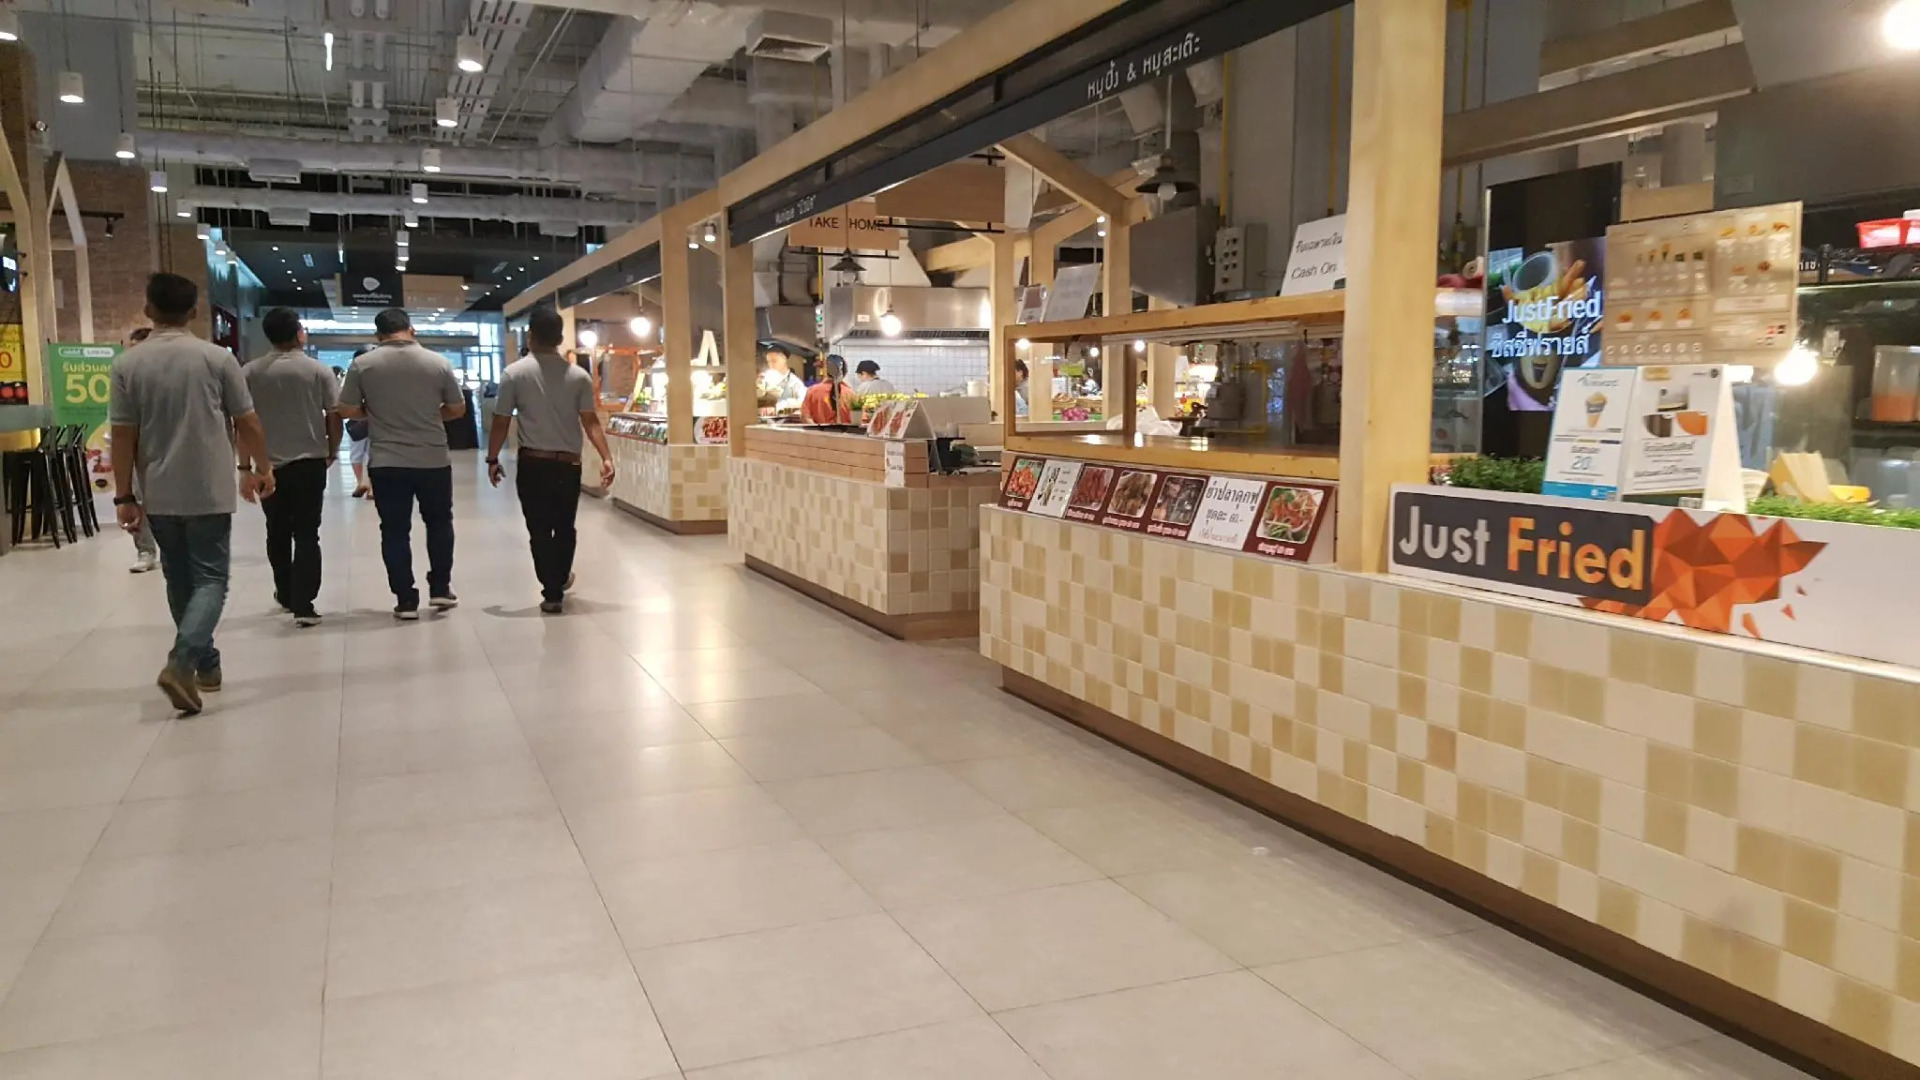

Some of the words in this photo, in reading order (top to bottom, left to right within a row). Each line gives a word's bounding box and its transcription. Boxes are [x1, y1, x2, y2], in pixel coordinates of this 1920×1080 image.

[1126, 62, 1137, 82] &
[849, 218, 885, 231] HOME
[1291, 266, 1318, 280] Cash
[65, 373, 111, 404] 50
[1399, 505, 1490, 566] Just
[1507, 516, 1646, 591] Fried
